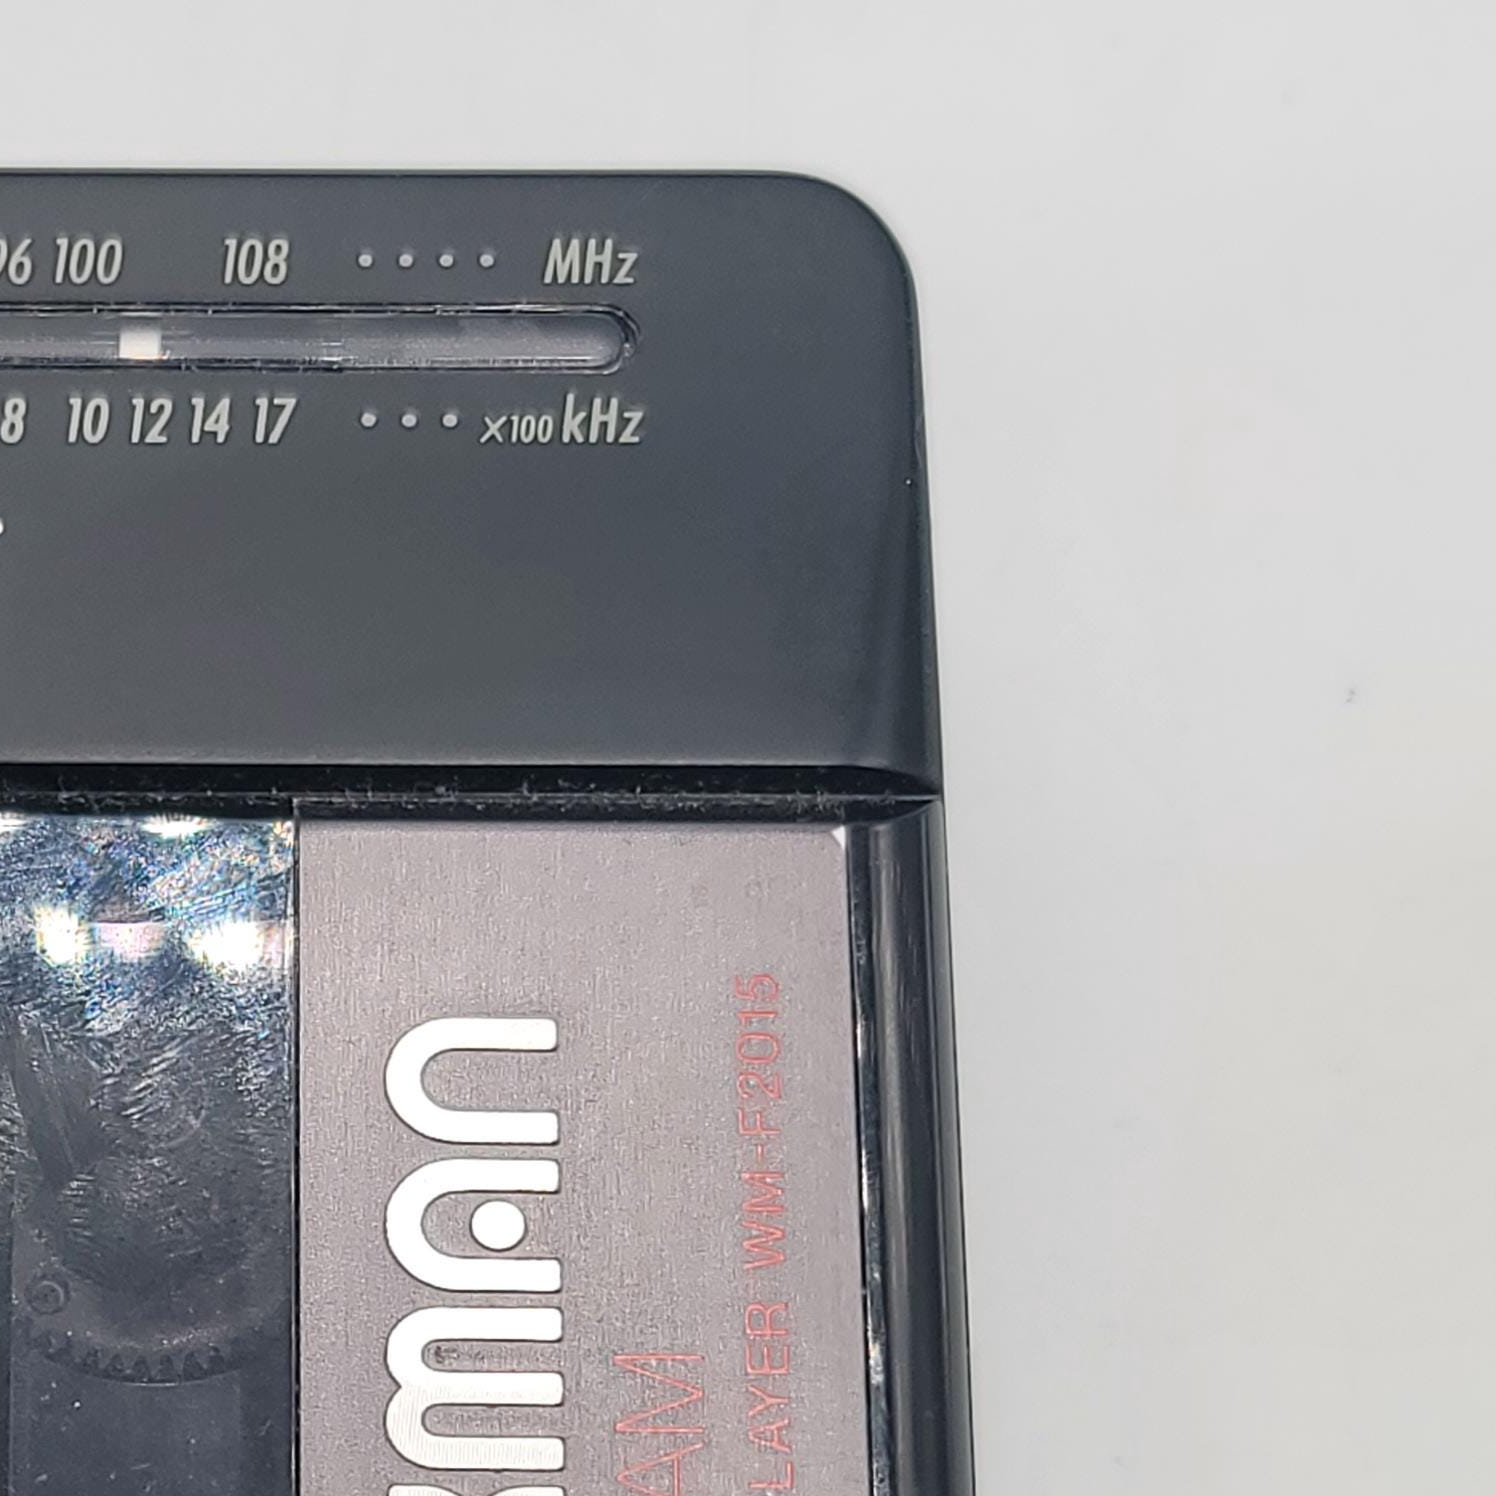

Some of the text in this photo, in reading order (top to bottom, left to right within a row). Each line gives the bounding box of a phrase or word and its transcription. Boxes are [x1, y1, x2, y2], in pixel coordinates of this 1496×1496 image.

[53, 237, 124, 286] 100
[222, 237, 290, 285] 108
[543, 238, 639, 286] MHz
[0, 397, 27, 444] 8
[67, 397, 109, 444] 10
[129, 397, 173, 444] 12
[189, 397, 230, 444] 14
[254, 397, 297, 444] 17
[560, 393, 645, 444] kHz
[735, 972, 786, 1271] WM-F2015
